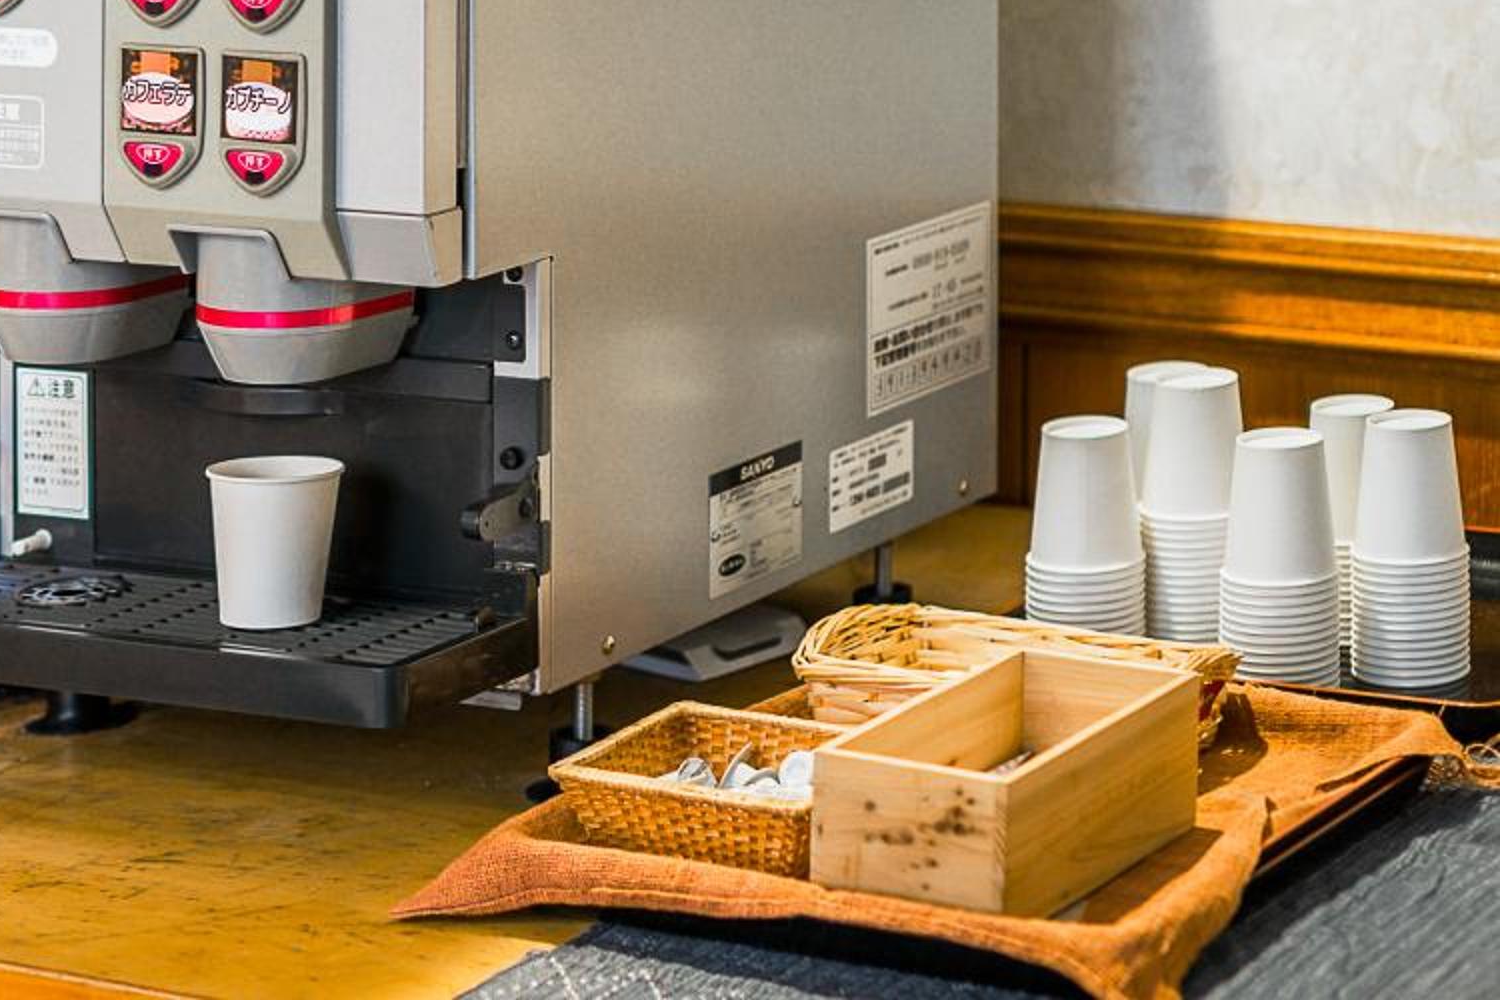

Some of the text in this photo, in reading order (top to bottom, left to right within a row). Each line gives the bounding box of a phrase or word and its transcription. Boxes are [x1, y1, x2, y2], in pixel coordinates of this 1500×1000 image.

[124, 80, 193, 106] カフェラテ
[226, 86, 292, 114] カプチーノ
